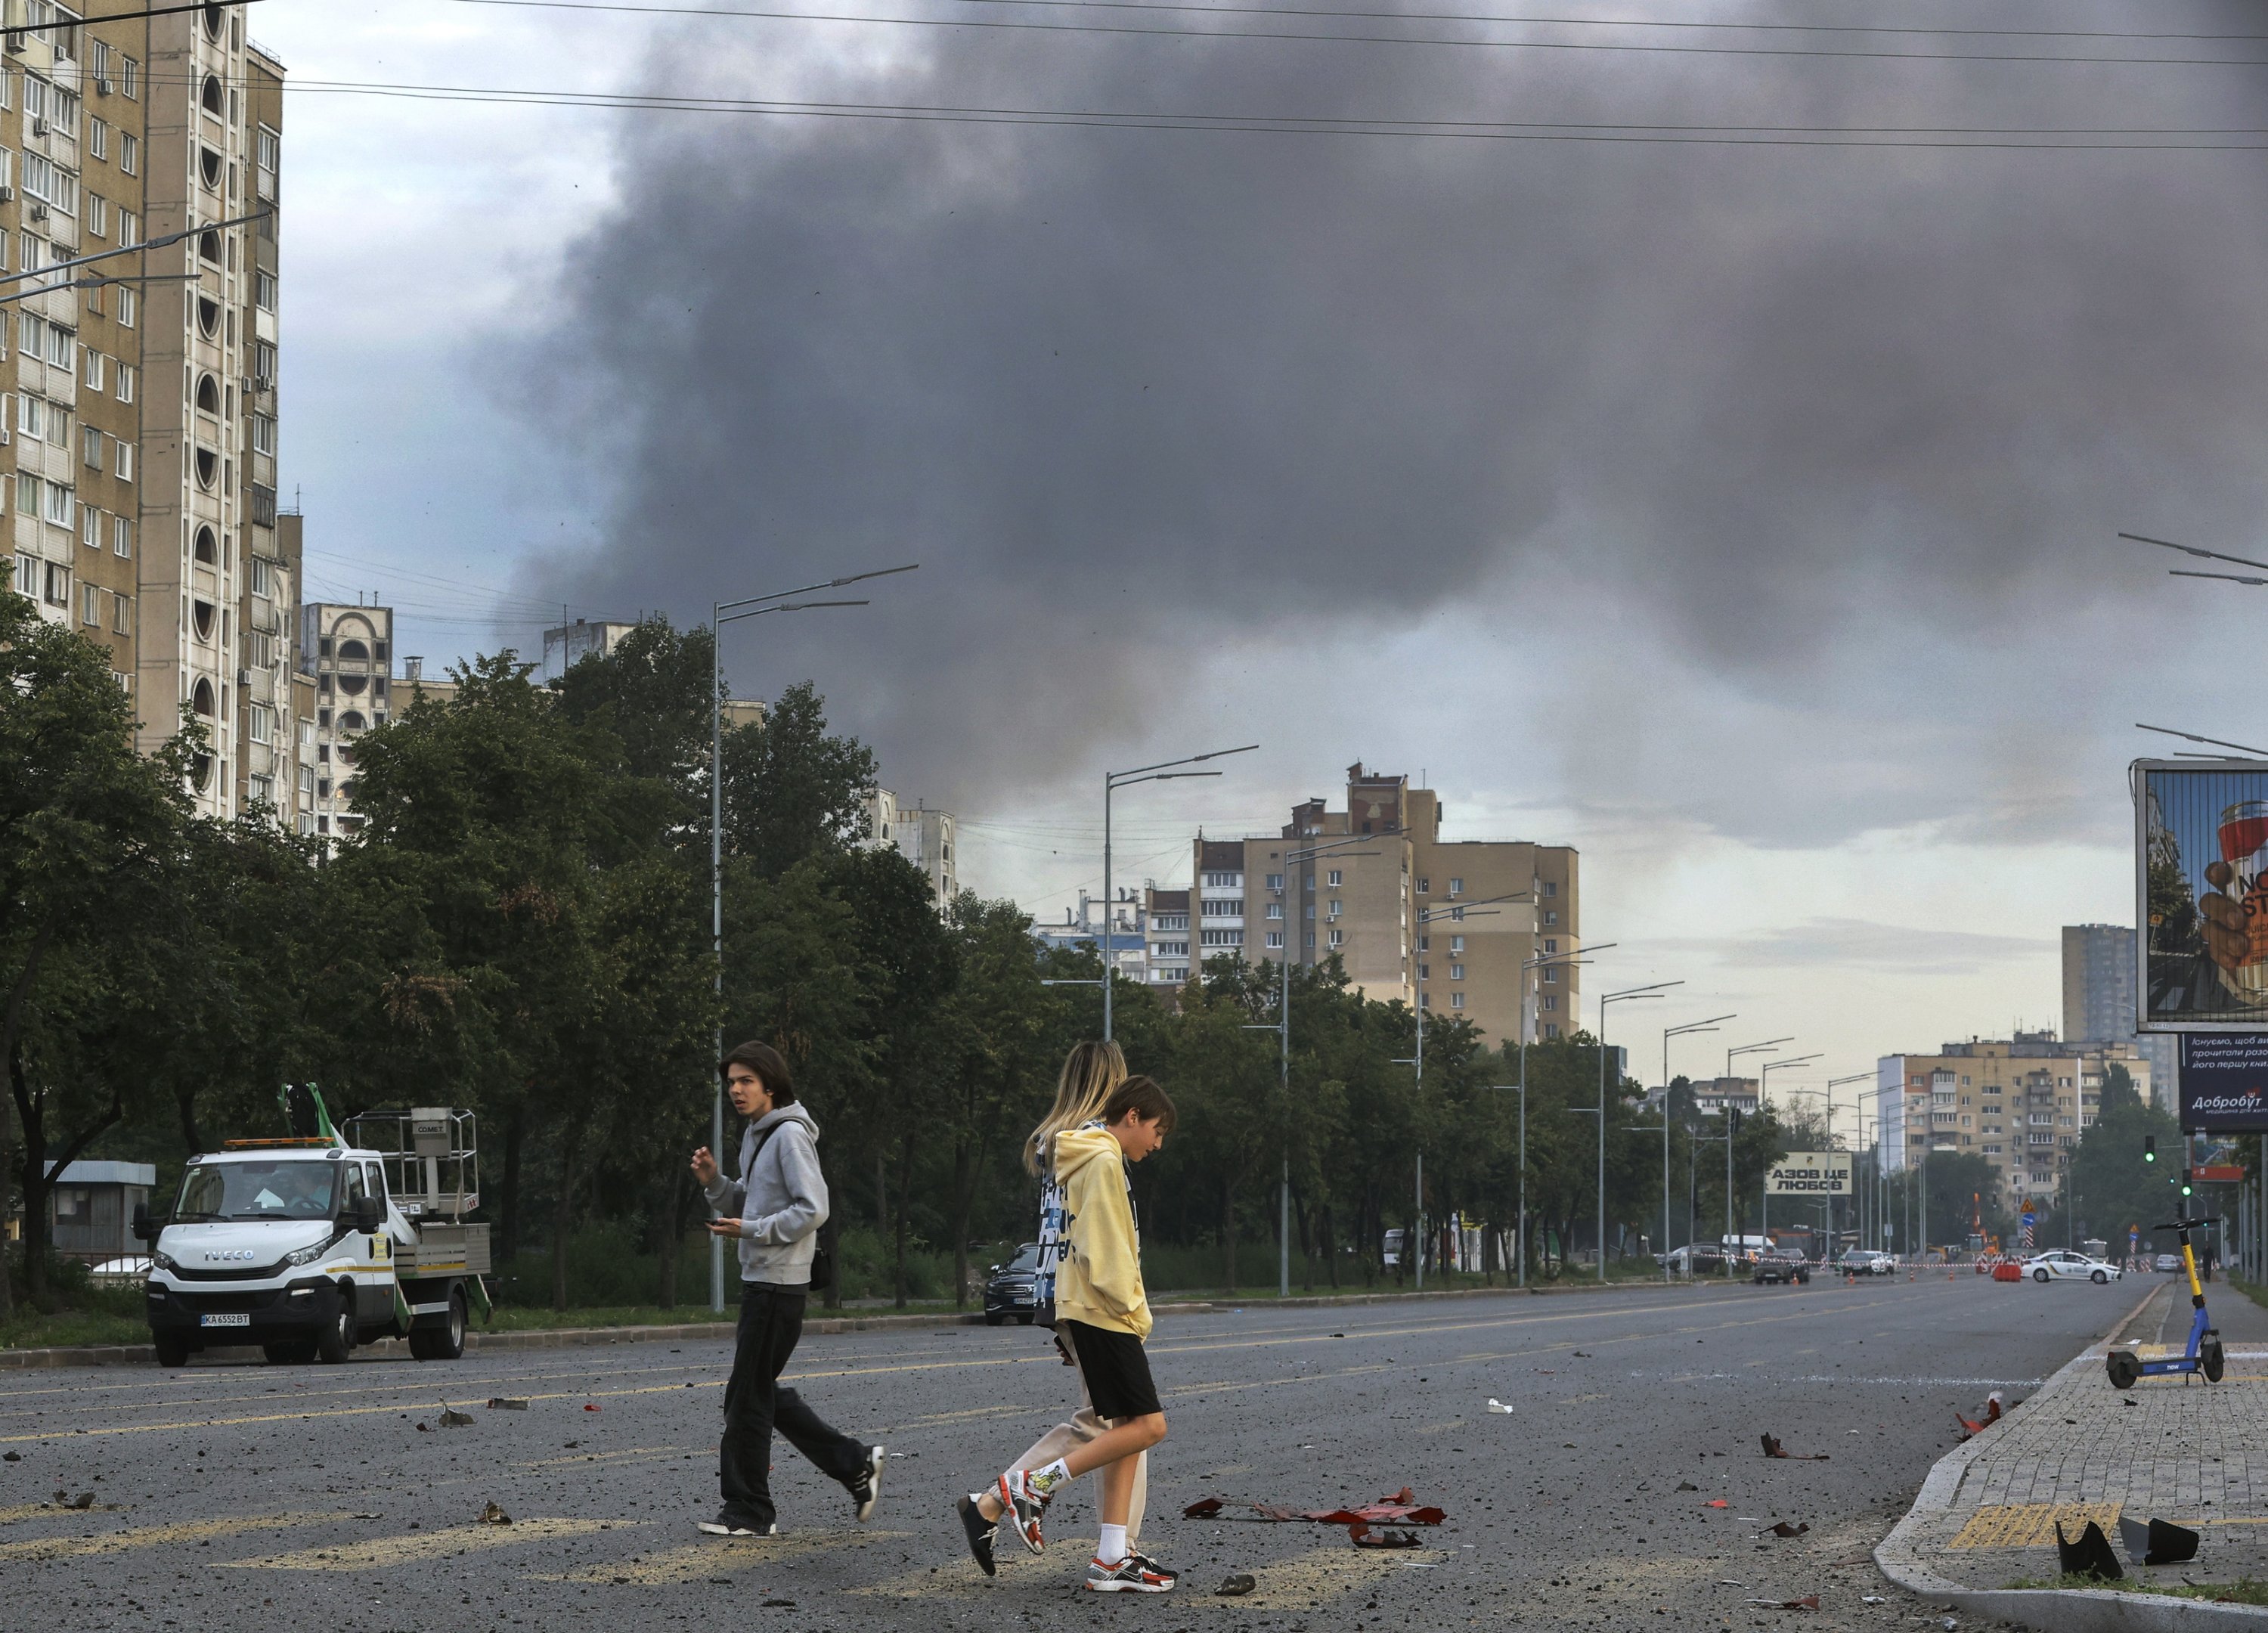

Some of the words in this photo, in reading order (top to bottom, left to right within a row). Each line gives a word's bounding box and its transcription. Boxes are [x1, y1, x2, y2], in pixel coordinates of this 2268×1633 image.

[2192, 1037, 2232, 1046] Існуємо,
[2235, 1037, 2256, 1046] щоб
[2192, 1049, 2244, 1058] прочитали
[2192, 1060, 2215, 1069] його
[2217, 1061, 2248, 1070] першу
[2192, 1095, 2262, 1110] Добробут
[1771, 1169, 1820, 1179] АЗОВ
[1824, 1169, 1848, 1181] ЦЕ
[1777, 1180, 1843, 1191] ЛЮБОВ
[205, 1250, 254, 1261] IVECO
